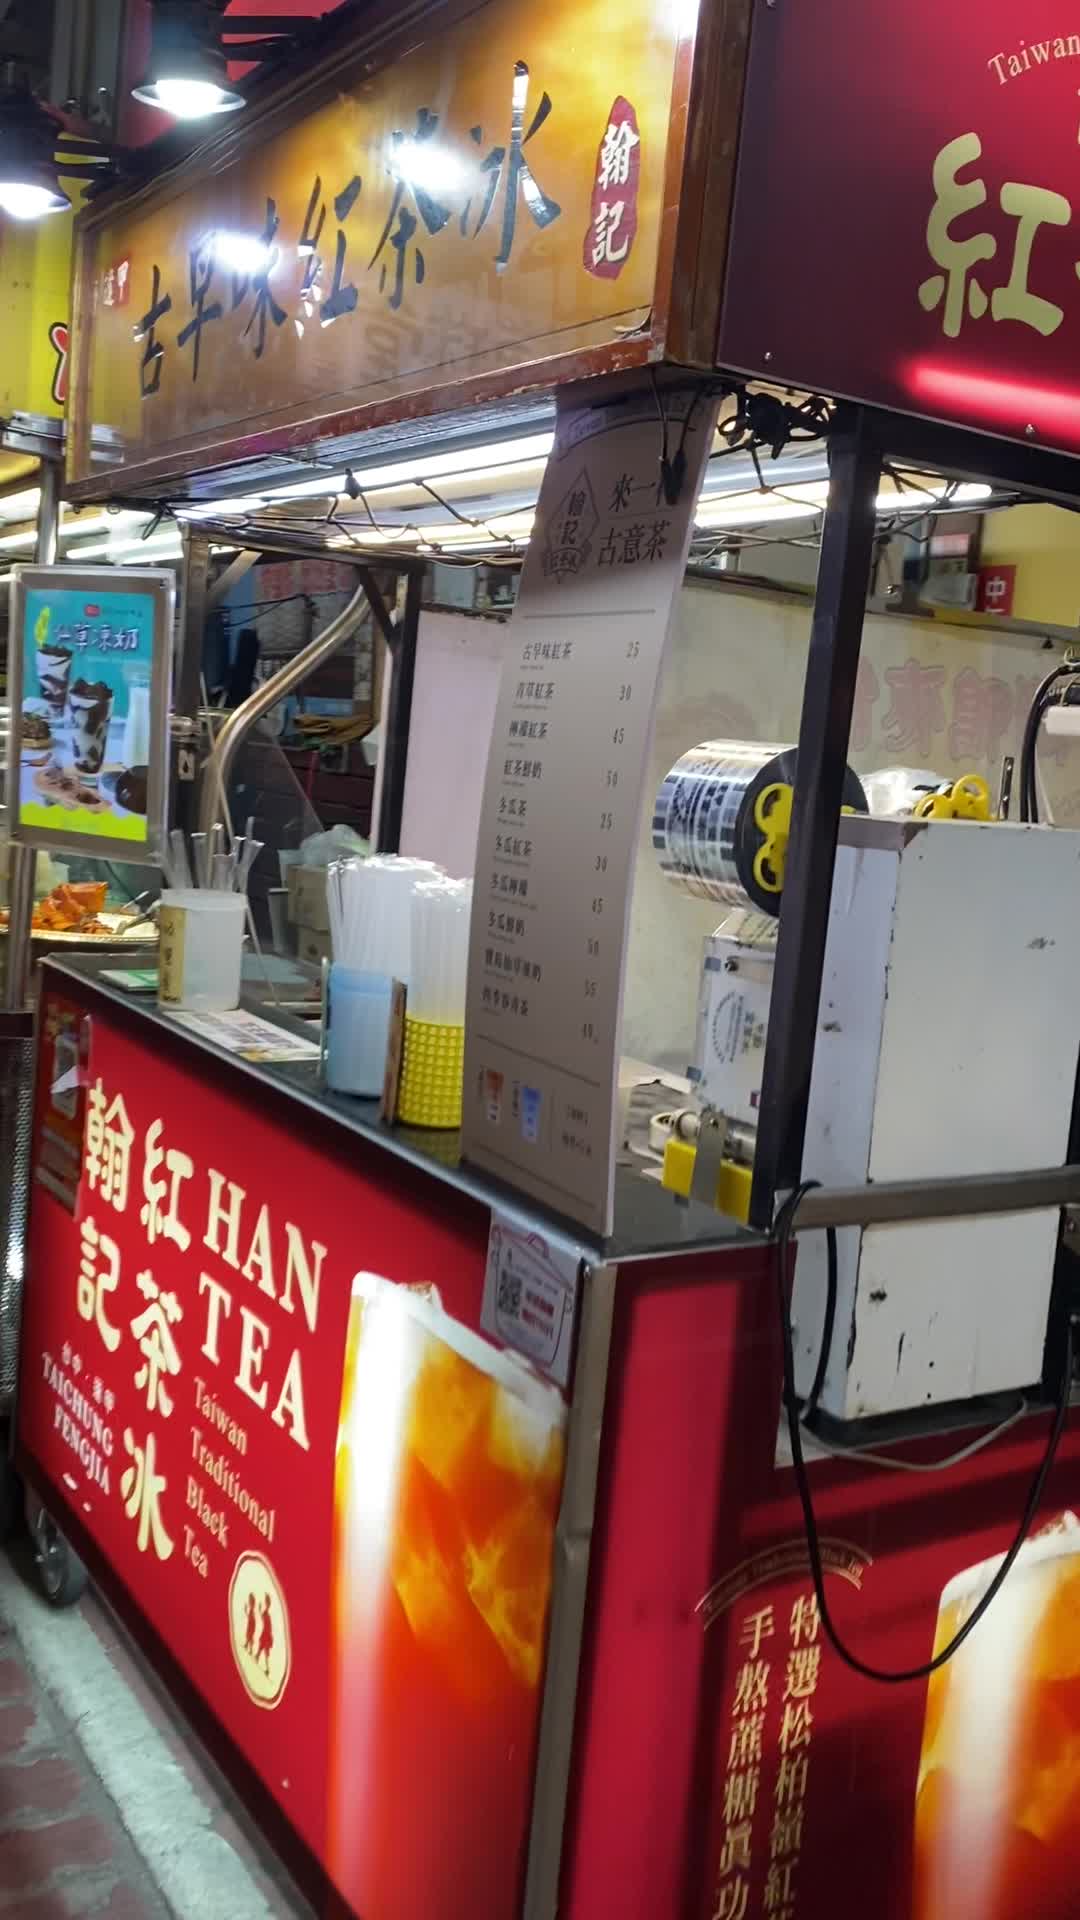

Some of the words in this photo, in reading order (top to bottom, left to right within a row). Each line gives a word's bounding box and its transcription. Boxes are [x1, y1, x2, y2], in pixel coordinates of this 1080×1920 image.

[987, 34, 1080, 86] Taiwan
[592, 120, 640, 266] 翰記
[918, 132, 1080, 338] 紅
[598, 520, 671, 567] 古意茶
[985, 577, 1007, 613] 中
[522, 641, 573, 660] 古早味紅茶
[626, 641, 640, 659] 25
[619, 685, 632, 701] 30
[613, 728, 625, 744] 45
[606, 770, 618, 787] 50
[600, 812, 613, 830] 25
[594, 855, 608, 872] 30
[77, 1077, 135, 1352] 翰記
[203, 1168, 327, 1334] HAN
[120, 1118, 194, 1561] 紅茶冰
[198, 1271, 310, 1451] TEA
[42, 1351, 113, 1457] TAICHUNG
[193, 1376, 247, 1455] Taiwan
[54, 1403, 110, 1495] FENGJIA
[190, 1426, 275, 1542] Traditional
[185, 1475, 229, 1548] Black
[183, 1524, 208, 1588] Tea
[763, 1592, 822, 1920] 特選松柏嶺紅
